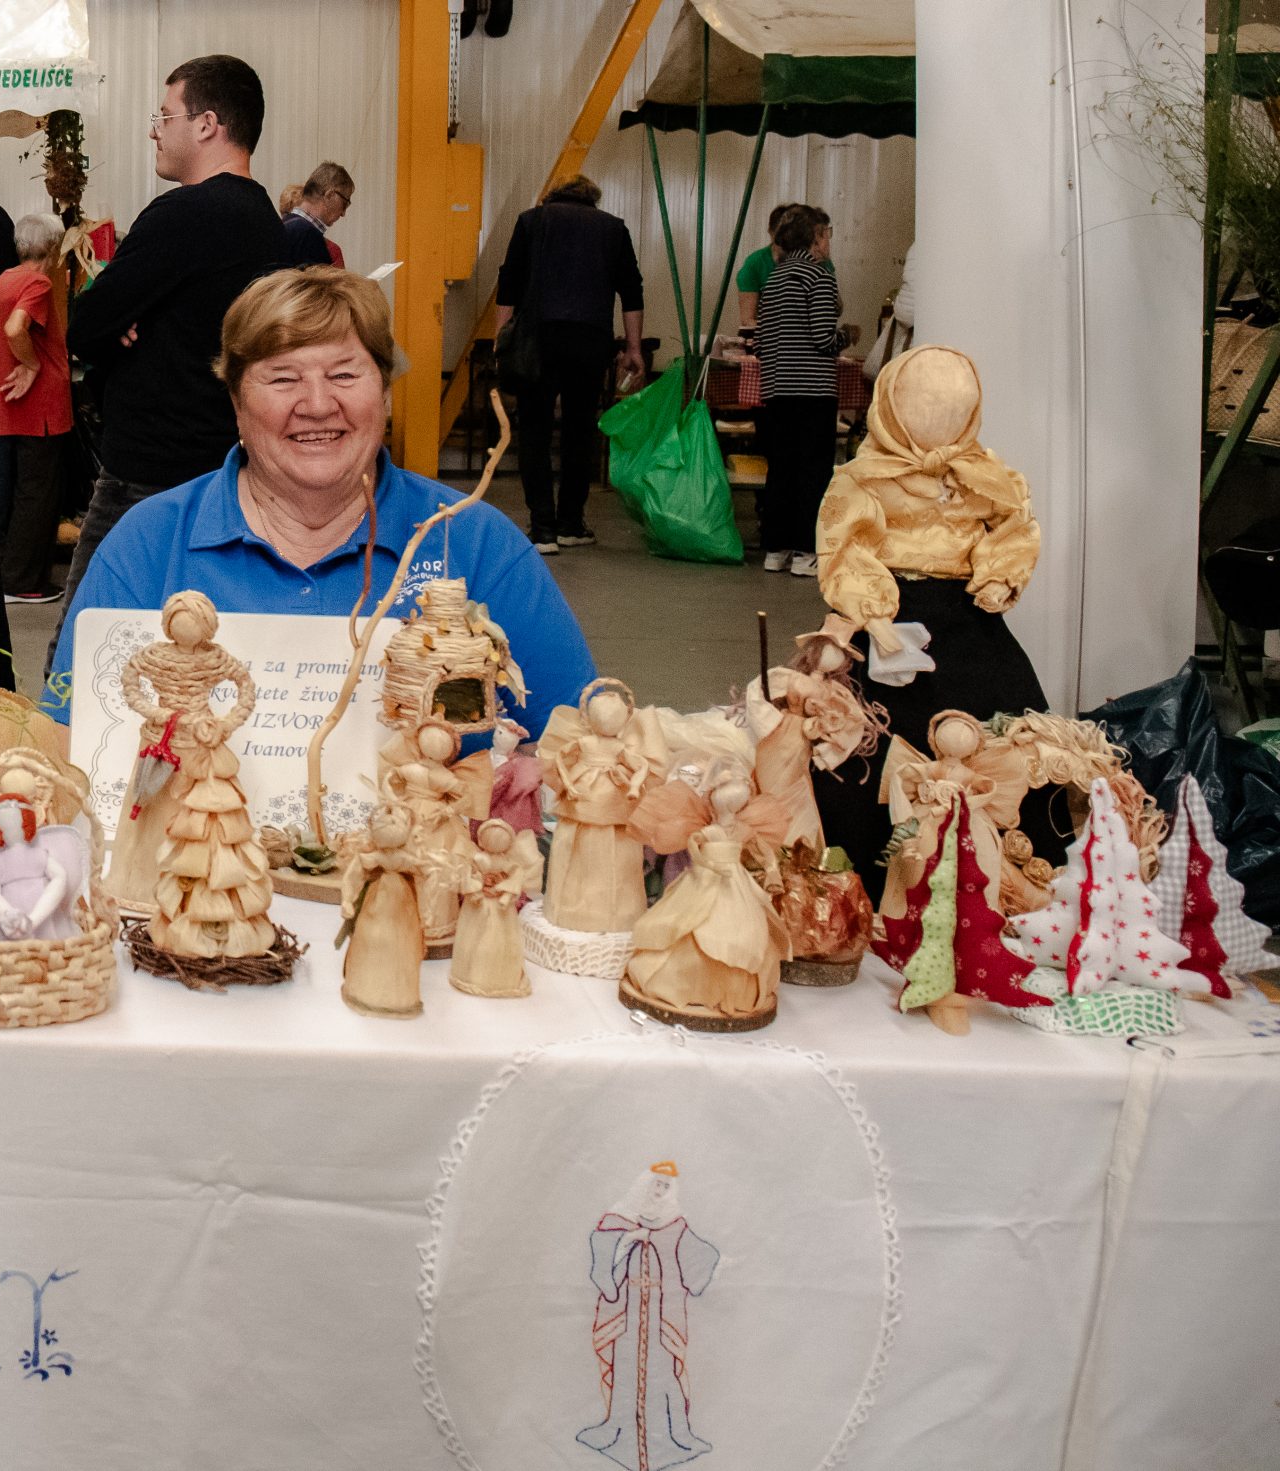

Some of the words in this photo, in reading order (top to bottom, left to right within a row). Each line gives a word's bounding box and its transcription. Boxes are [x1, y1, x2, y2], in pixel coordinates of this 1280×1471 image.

[264, 661, 286, 673] za
[252, 712, 323, 730] IZVOR
[242, 740, 325, 757] Ivanov
